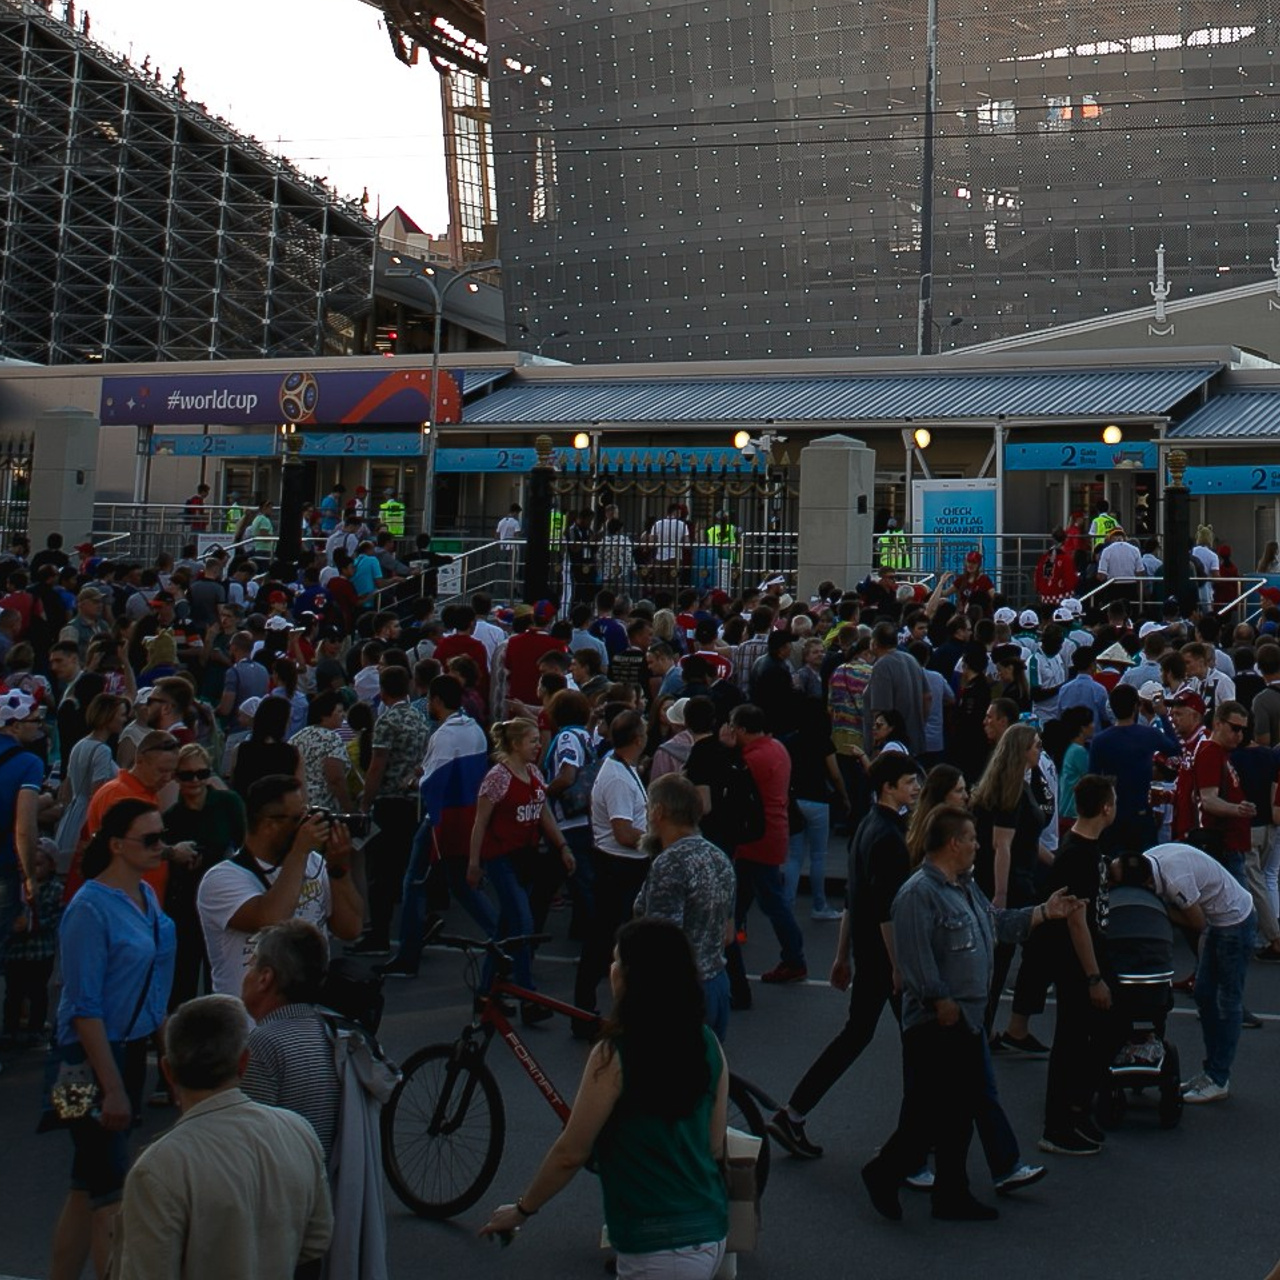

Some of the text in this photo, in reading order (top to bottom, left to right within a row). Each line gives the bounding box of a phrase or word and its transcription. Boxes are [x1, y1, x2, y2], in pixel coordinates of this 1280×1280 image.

[167, 389, 258, 414] #worldcup
[202, 435, 213, 453] 2
[343, 434, 355, 453] 2
[496, 450, 509, 469] 2
[1061, 445, 1077, 467] 2
[1251, 468, 1268, 490] 2
[935, 516, 983, 525] YOUR FLAG
[943, 507, 972, 516] CHECK
[933, 525, 984, 534] OR BANNER
[505, 1032, 564, 1105] FORMAT
